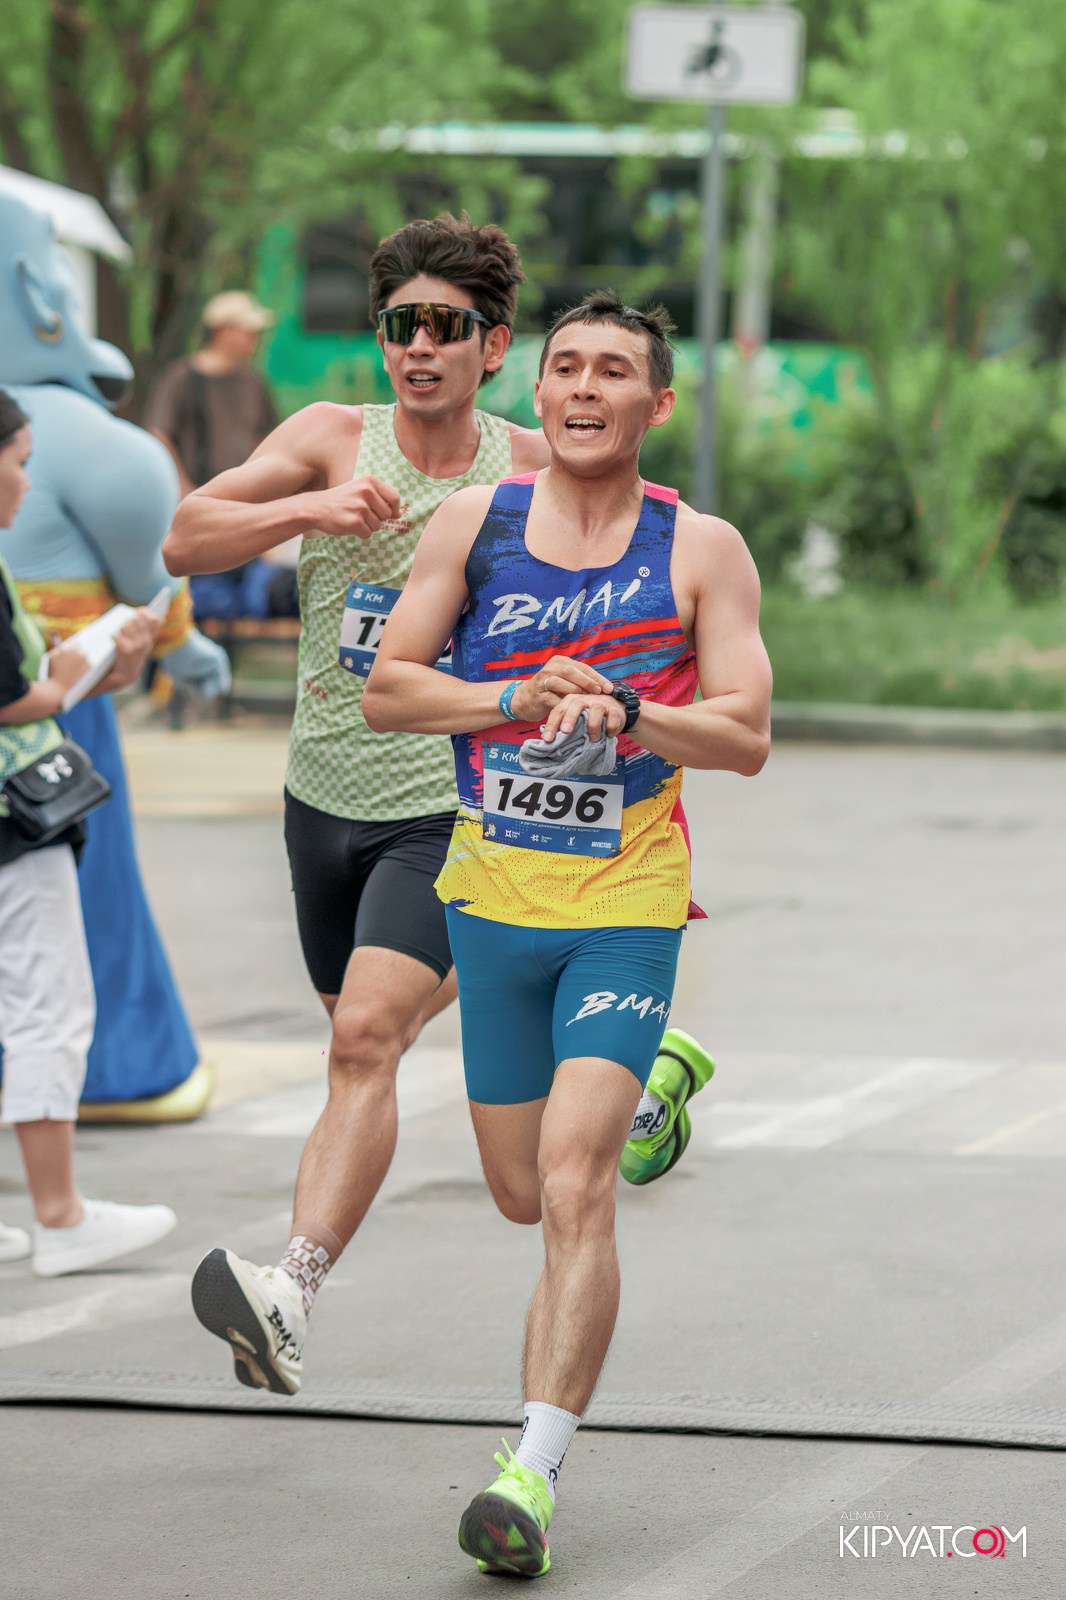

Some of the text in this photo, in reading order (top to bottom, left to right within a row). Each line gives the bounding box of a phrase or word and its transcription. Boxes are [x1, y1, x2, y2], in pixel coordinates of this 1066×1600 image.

[353, 588, 384, 603] 5 KM
[489, 747, 520, 763] 5 KM
[497, 778, 608, 823] 1496
